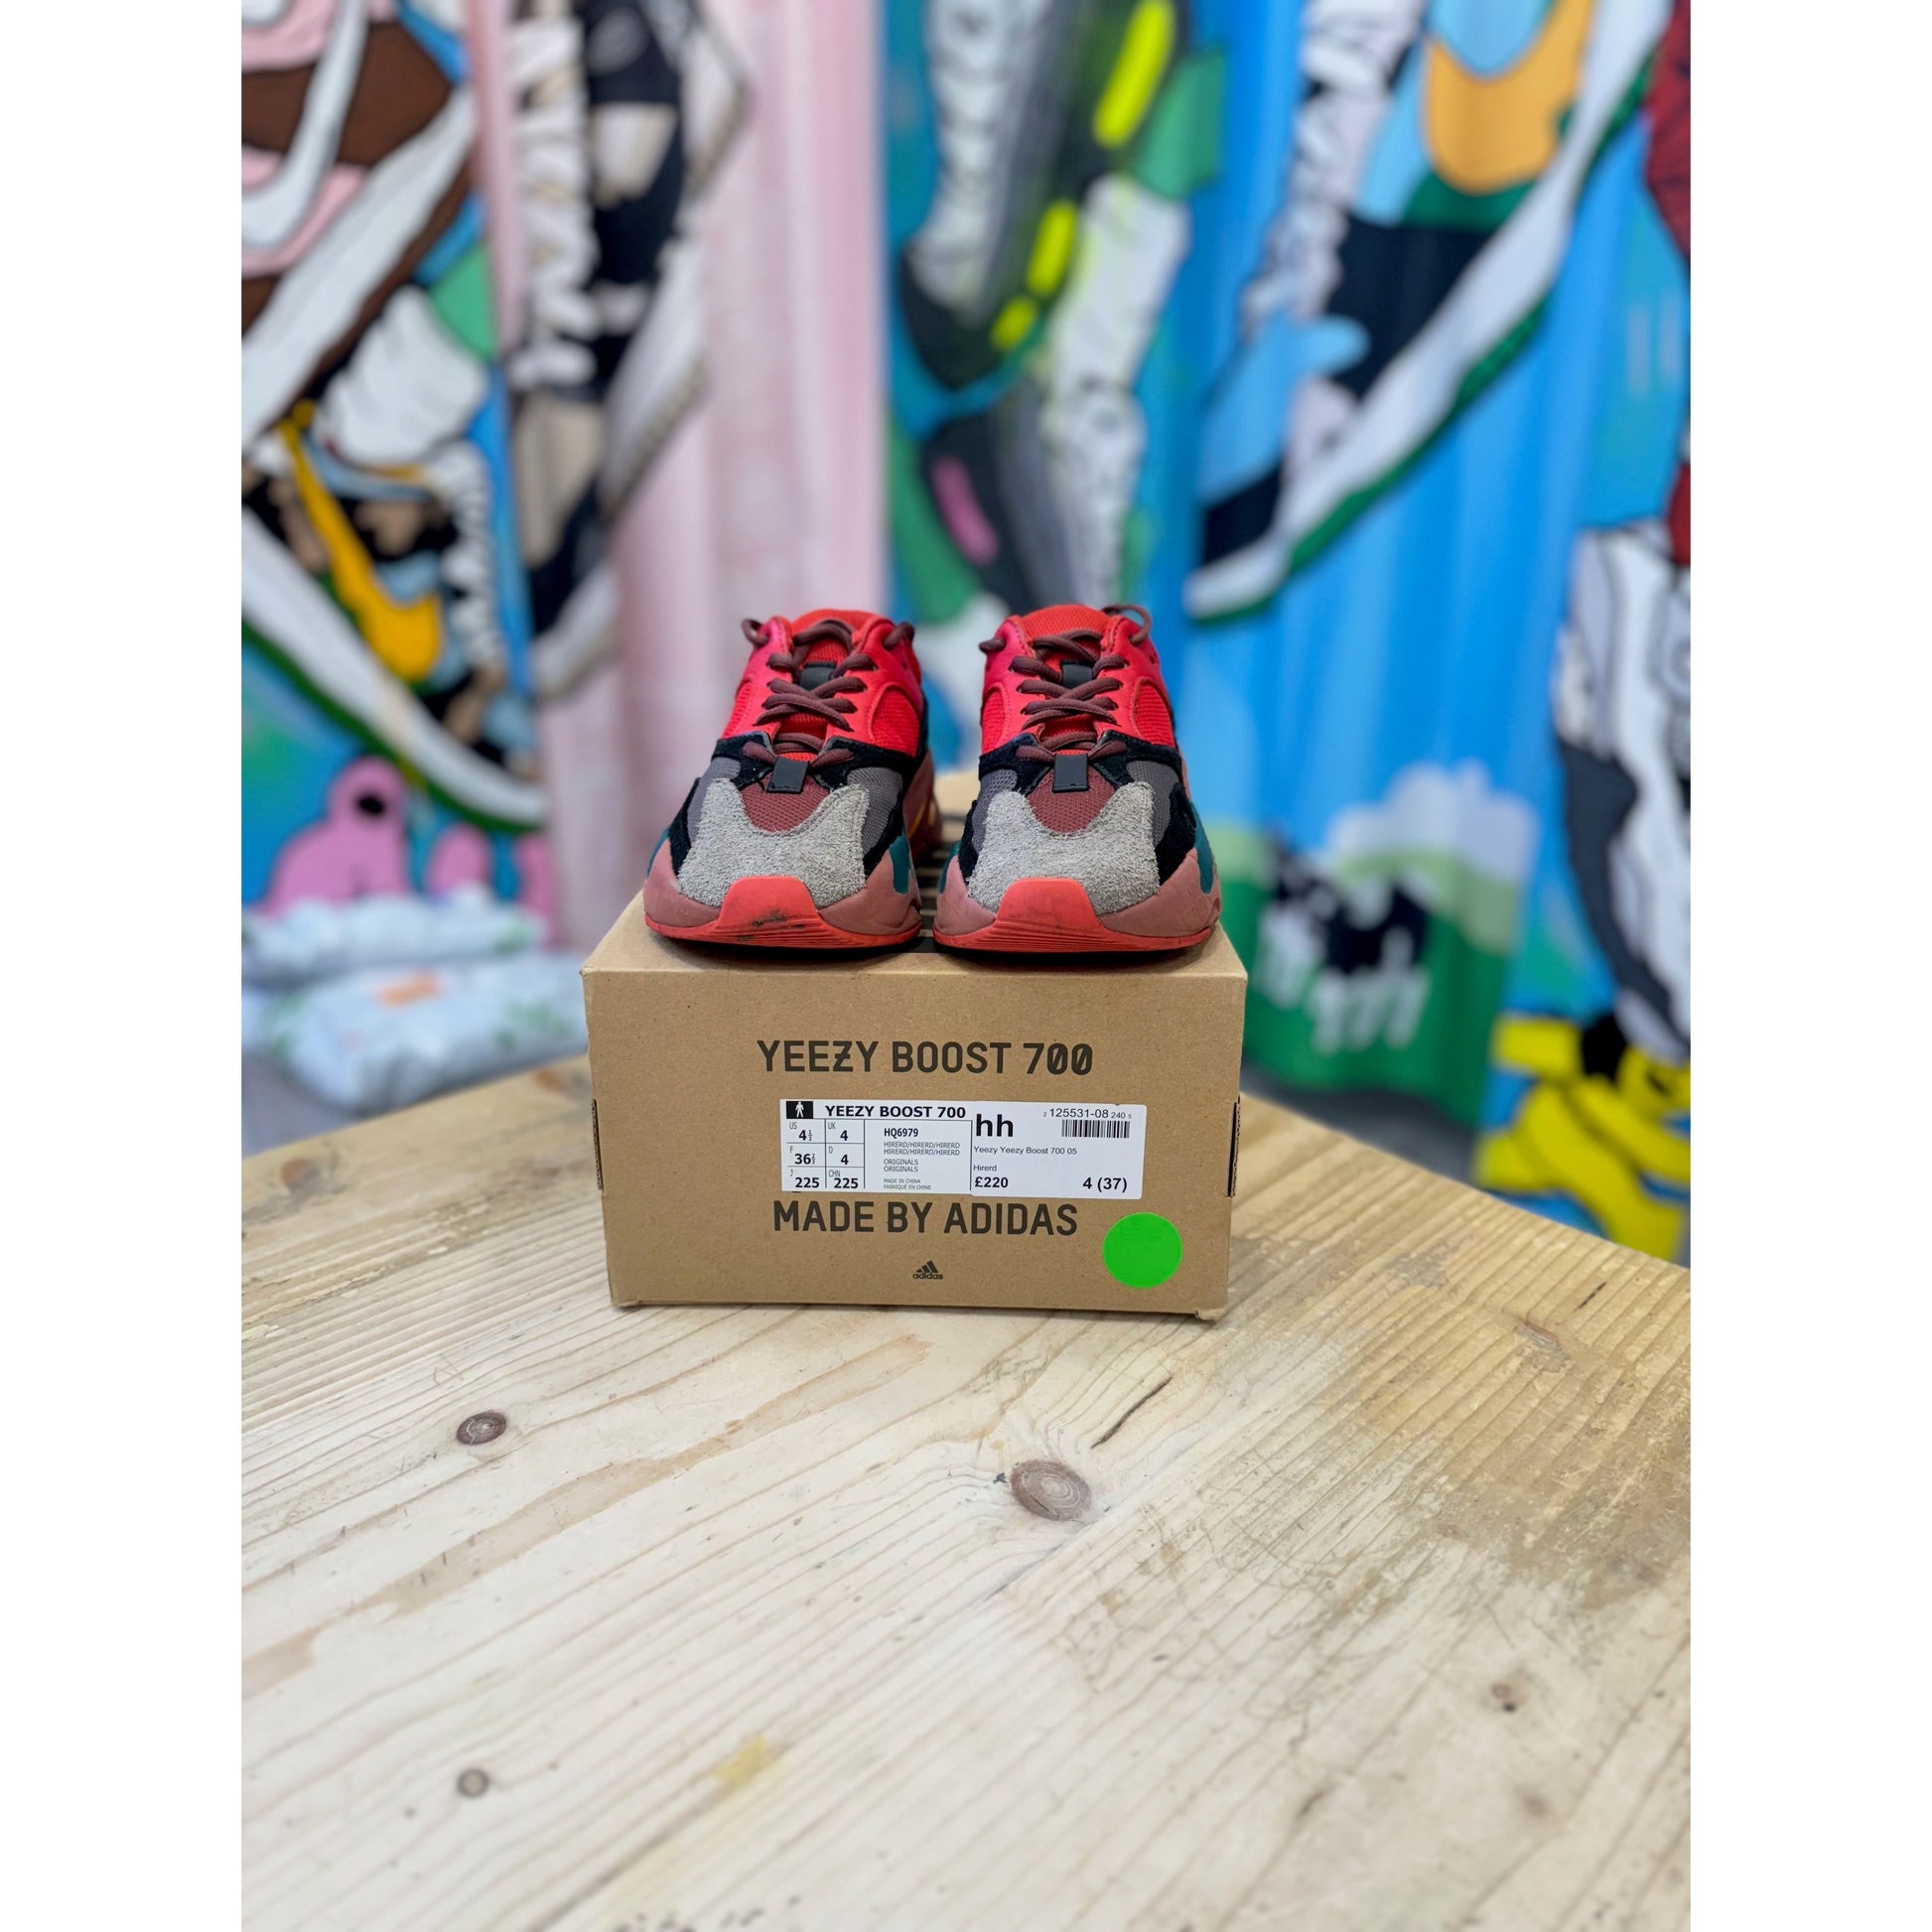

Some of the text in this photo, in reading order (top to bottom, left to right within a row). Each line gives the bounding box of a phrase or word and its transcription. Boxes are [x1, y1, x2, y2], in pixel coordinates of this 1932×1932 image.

[892, 1041, 1012, 1074] BOOST
[1023, 1043, 1093, 1075] 700
[825, 1105, 966, 1118] YEEZY BOOST 700
[1049, 1108, 1109, 1119] 125531-08
[976, 1114, 1014, 1138] hh
[840, 1130, 849, 1141] 4
[884, 1128, 919, 1139] HQ6979
[1000, 1146, 1024, 1155] Yeezy
[840, 1154, 849, 1165] 4
[795, 1176, 820, 1188] 225
[834, 1177, 859, 1189] 225
[975, 1176, 1009, 1188] £220
[1083, 1177, 1128, 1192] 4 (37)
[773, 1200, 1077, 1235] MADE BY ADIDAS
[912, 1271, 943, 1280] adidas
